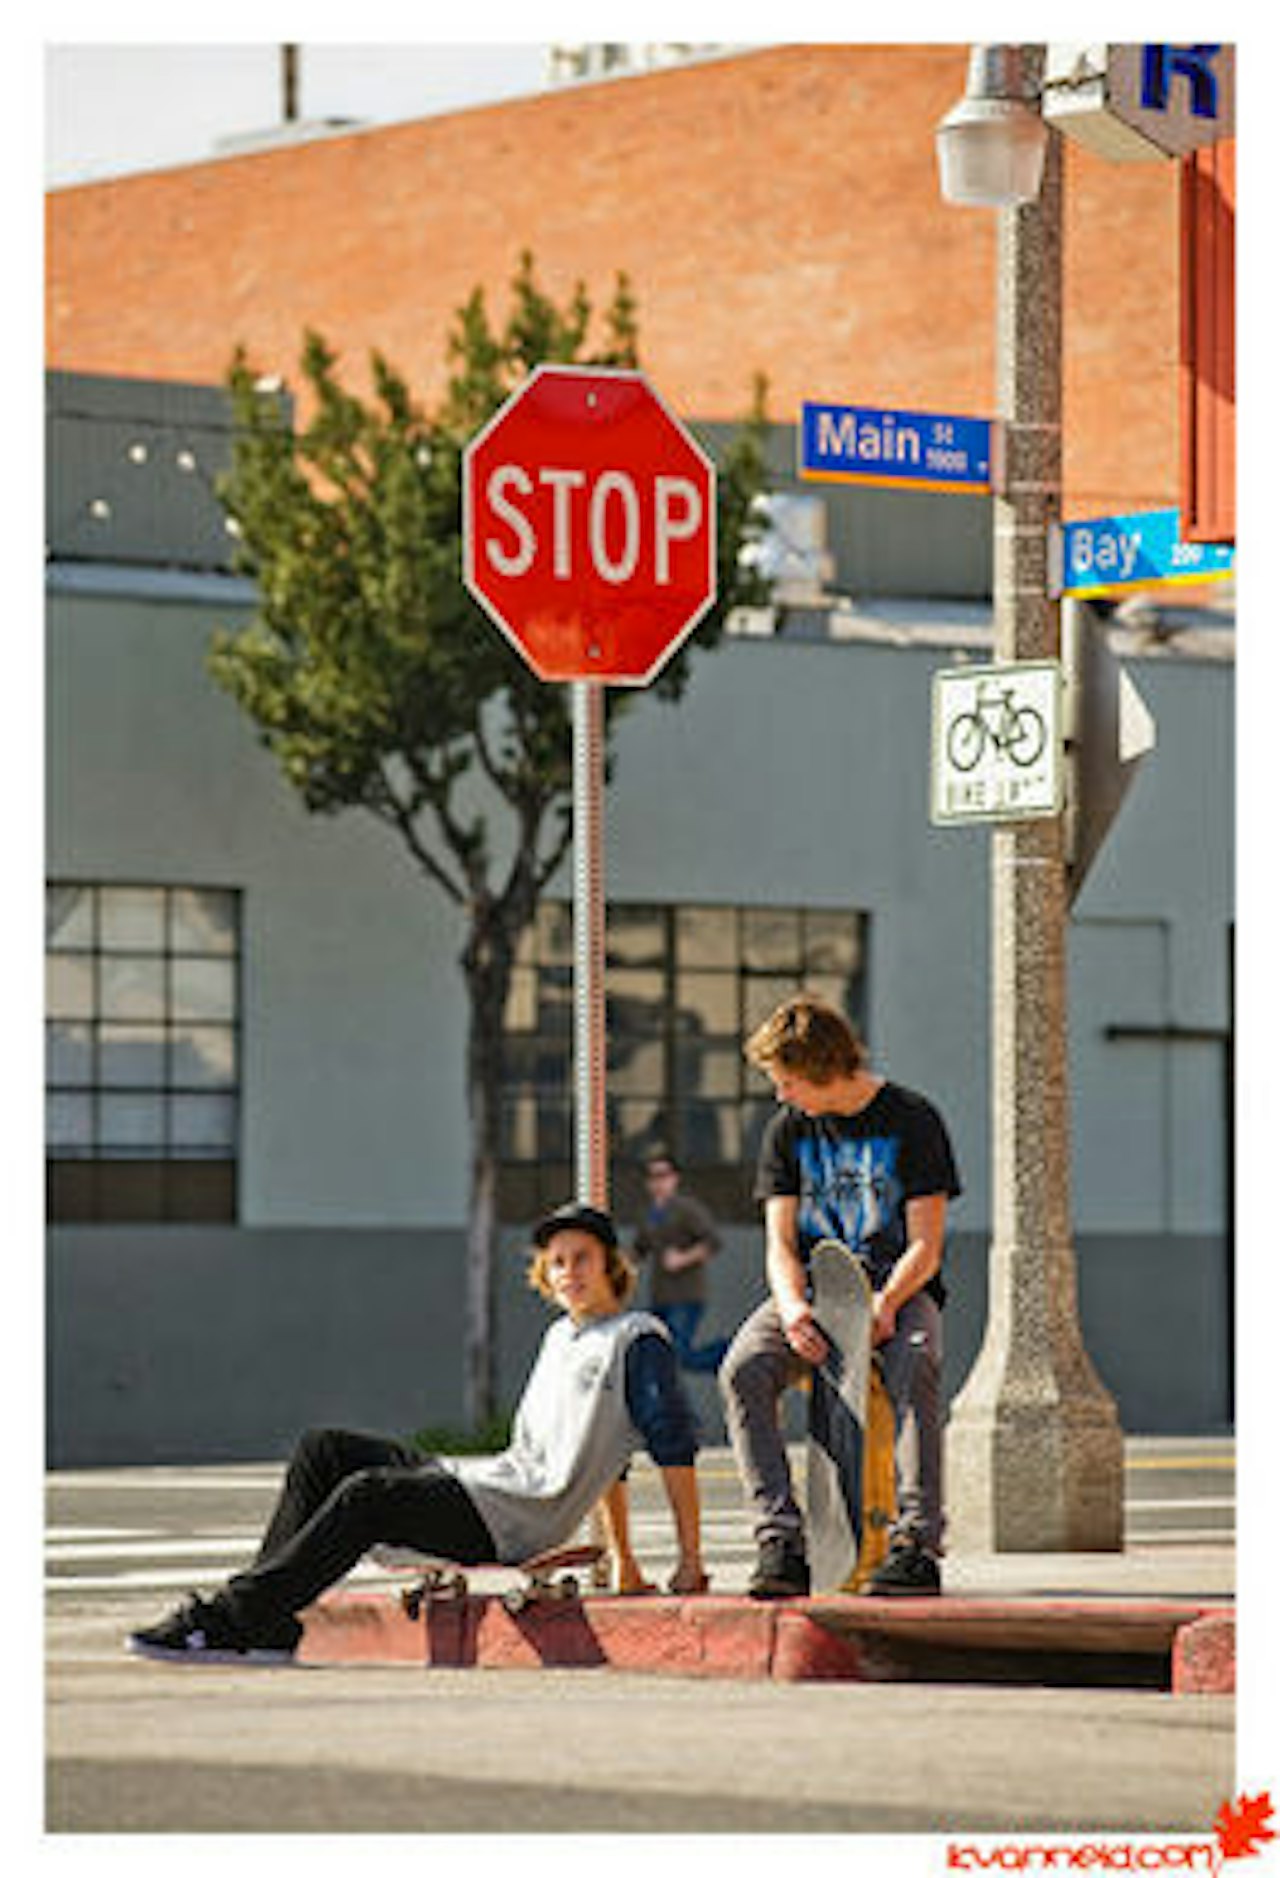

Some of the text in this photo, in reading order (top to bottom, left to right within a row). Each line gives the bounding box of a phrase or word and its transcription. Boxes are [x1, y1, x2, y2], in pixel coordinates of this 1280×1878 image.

[816, 411, 954, 463] Main St
[485, 464, 702, 586] STOP
[1071, 527, 1142, 580] Bay
